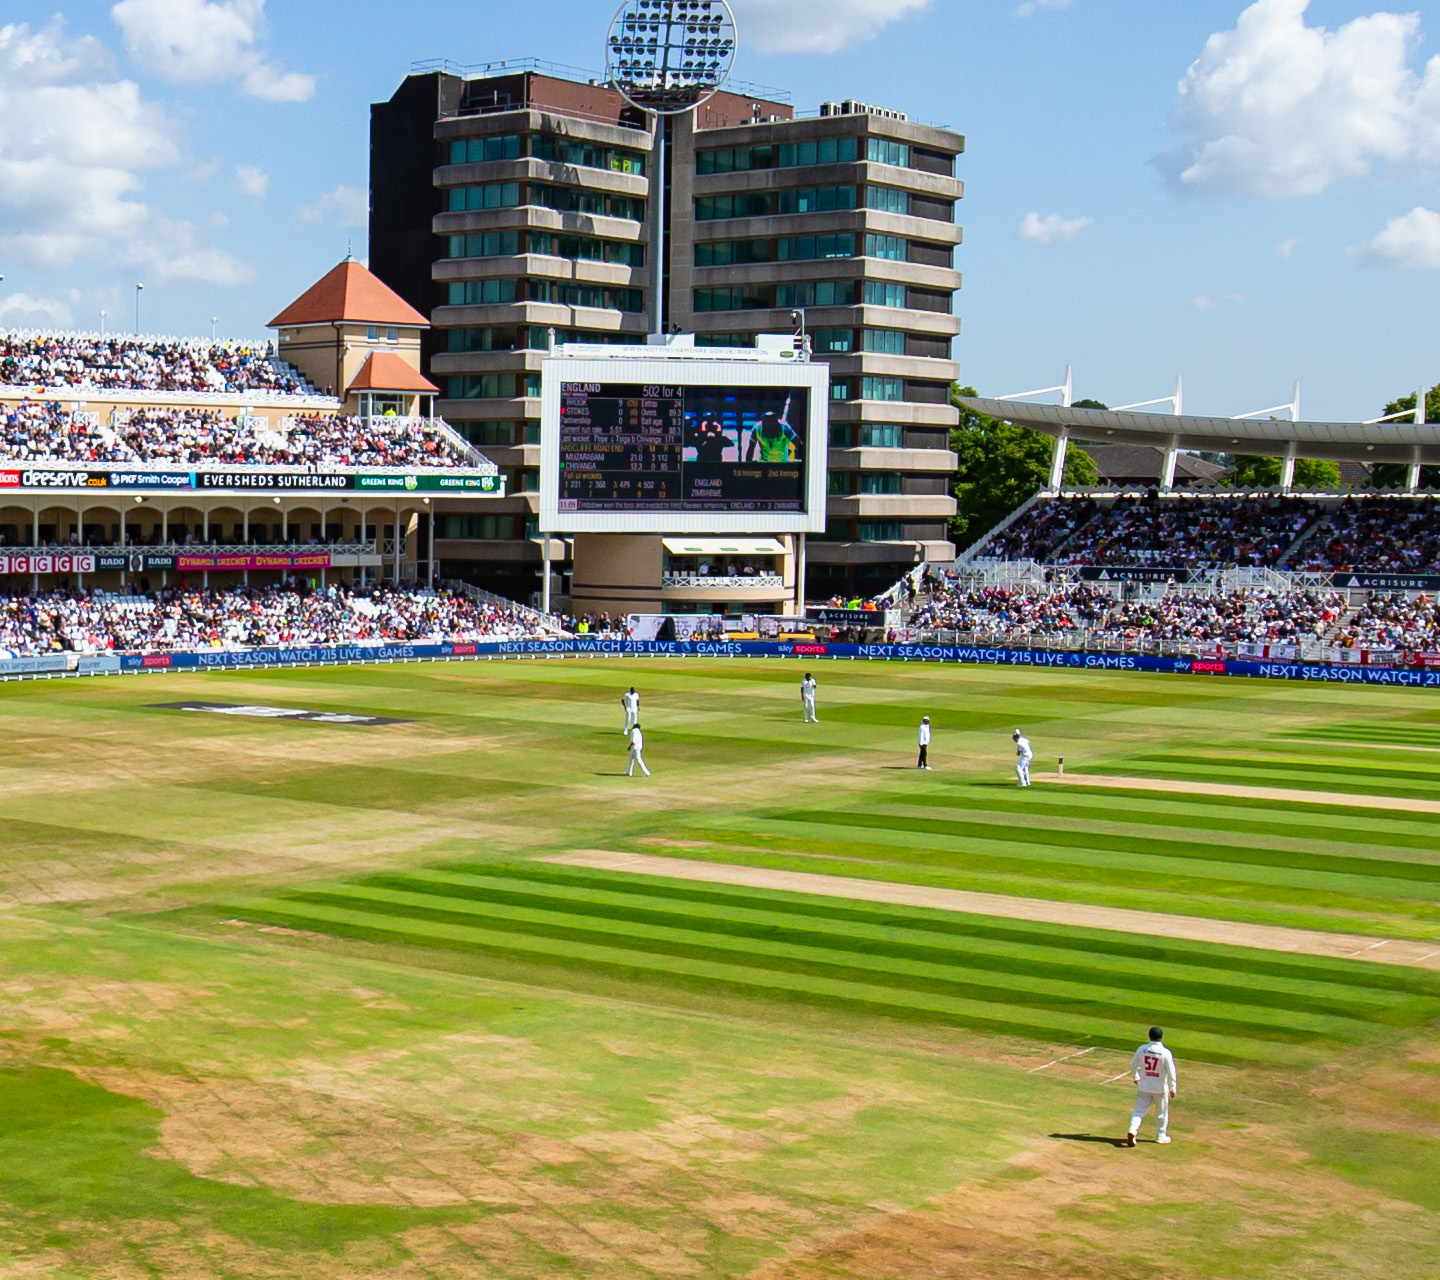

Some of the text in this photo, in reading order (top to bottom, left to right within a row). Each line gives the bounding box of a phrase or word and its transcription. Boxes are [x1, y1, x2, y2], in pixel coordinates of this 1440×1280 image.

[562, 382, 600, 393] ENGLAND
[643, 386, 660, 397] 502
[121, 474, 190, 486] PKF Smith Cooper
[203, 474, 346, 487] EVERSHEDS SUTHERLAND
[361, 478, 386, 486] GREENE
[440, 479, 464, 487] GREENE
[11, 557, 27, 572] IG
[33, 557, 48, 572] IG
[55, 556, 70, 571] IG
[100, 558, 125, 567] RADO
[148, 557, 173, 566] RADO
[1363, 578, 1423, 588] ACRISURE
[499, 641, 742, 653] NEXT SEASON WATCH 215 LIVE GAMES
[778, 644, 826, 654] sky sports
[198, 646, 414, 665] NEXT SEASON WATCH 215 LIVE GAMES
[858, 645, 1135, 668] NEXT SEASON WATCH 215 LIVE GAMES
[12, 659, 36, 671] largest
[38, 658, 66, 670] pension
[1174, 661, 1225, 671] sky sports
